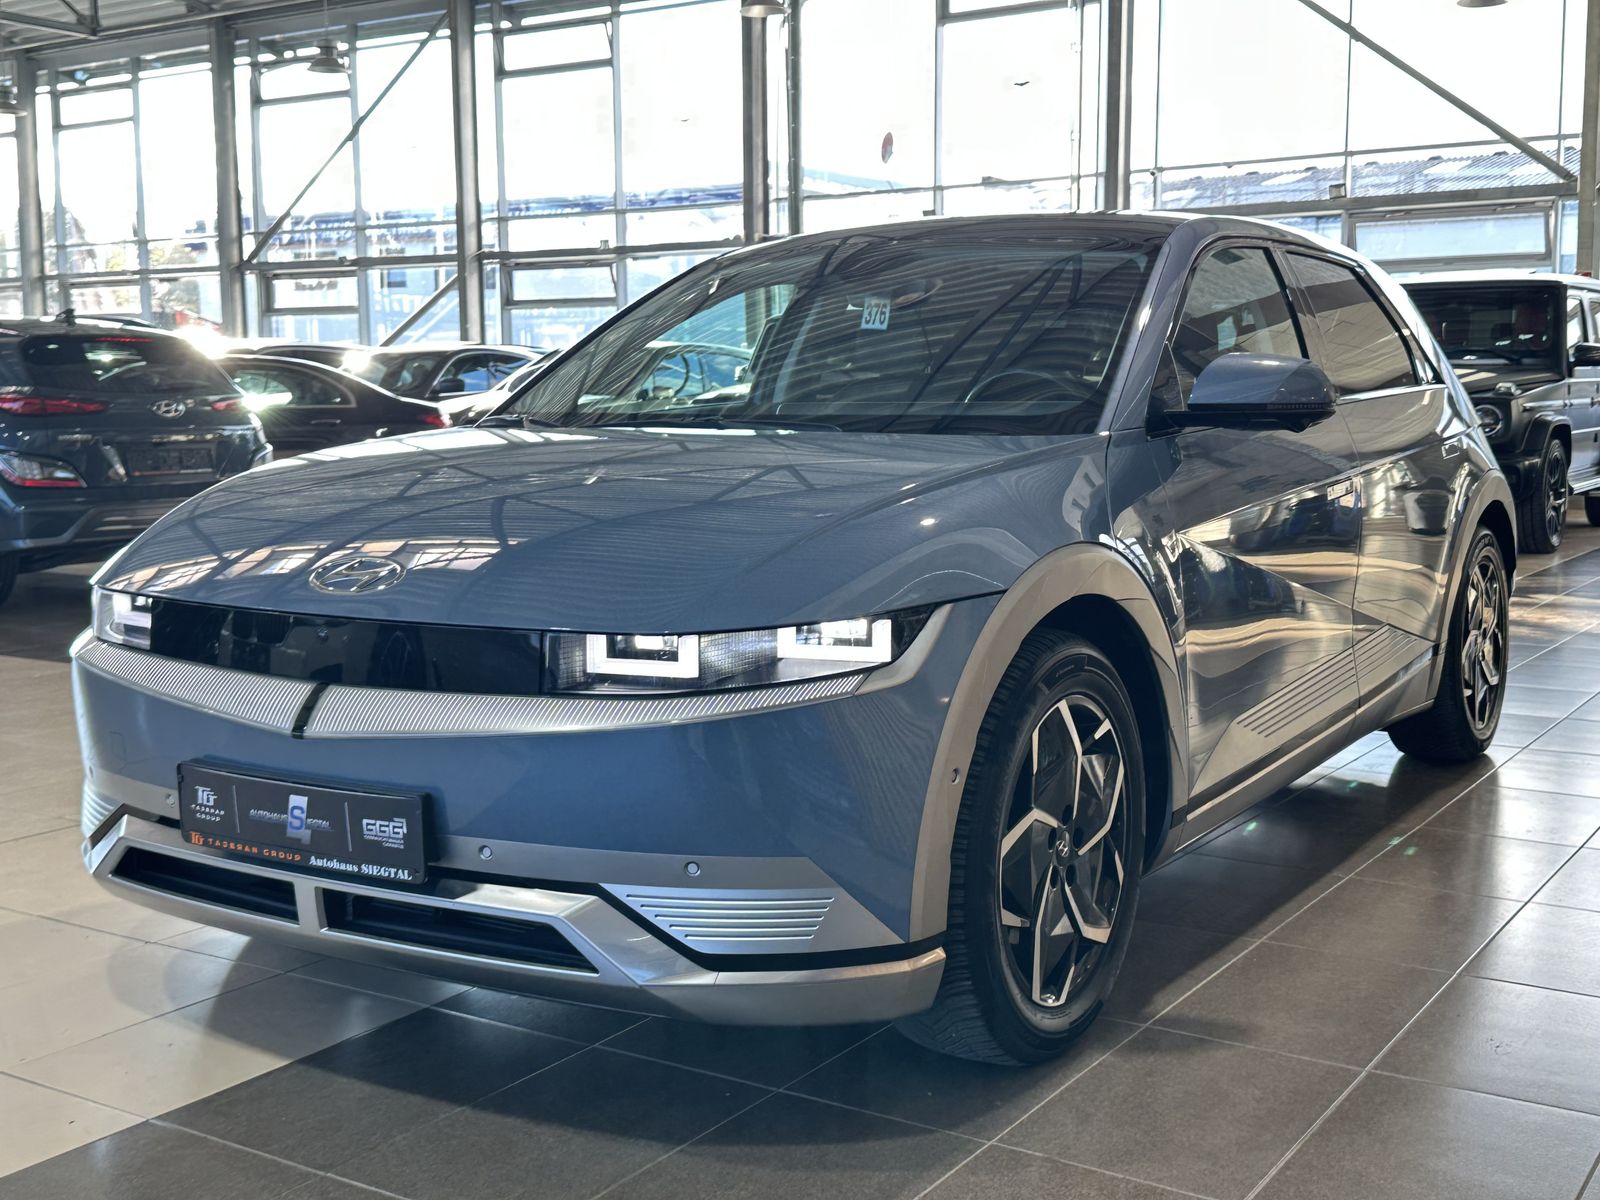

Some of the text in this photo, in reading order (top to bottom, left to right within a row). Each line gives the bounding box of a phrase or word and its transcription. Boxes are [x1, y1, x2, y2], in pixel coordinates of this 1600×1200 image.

[864, 302, 888, 325] 376
[196, 812, 221, 822] GROUP
[362, 817, 406, 839] GGG
[263, 849, 302, 861] GROUP
[309, 855, 413, 881] Autohaus SIEGTAL
